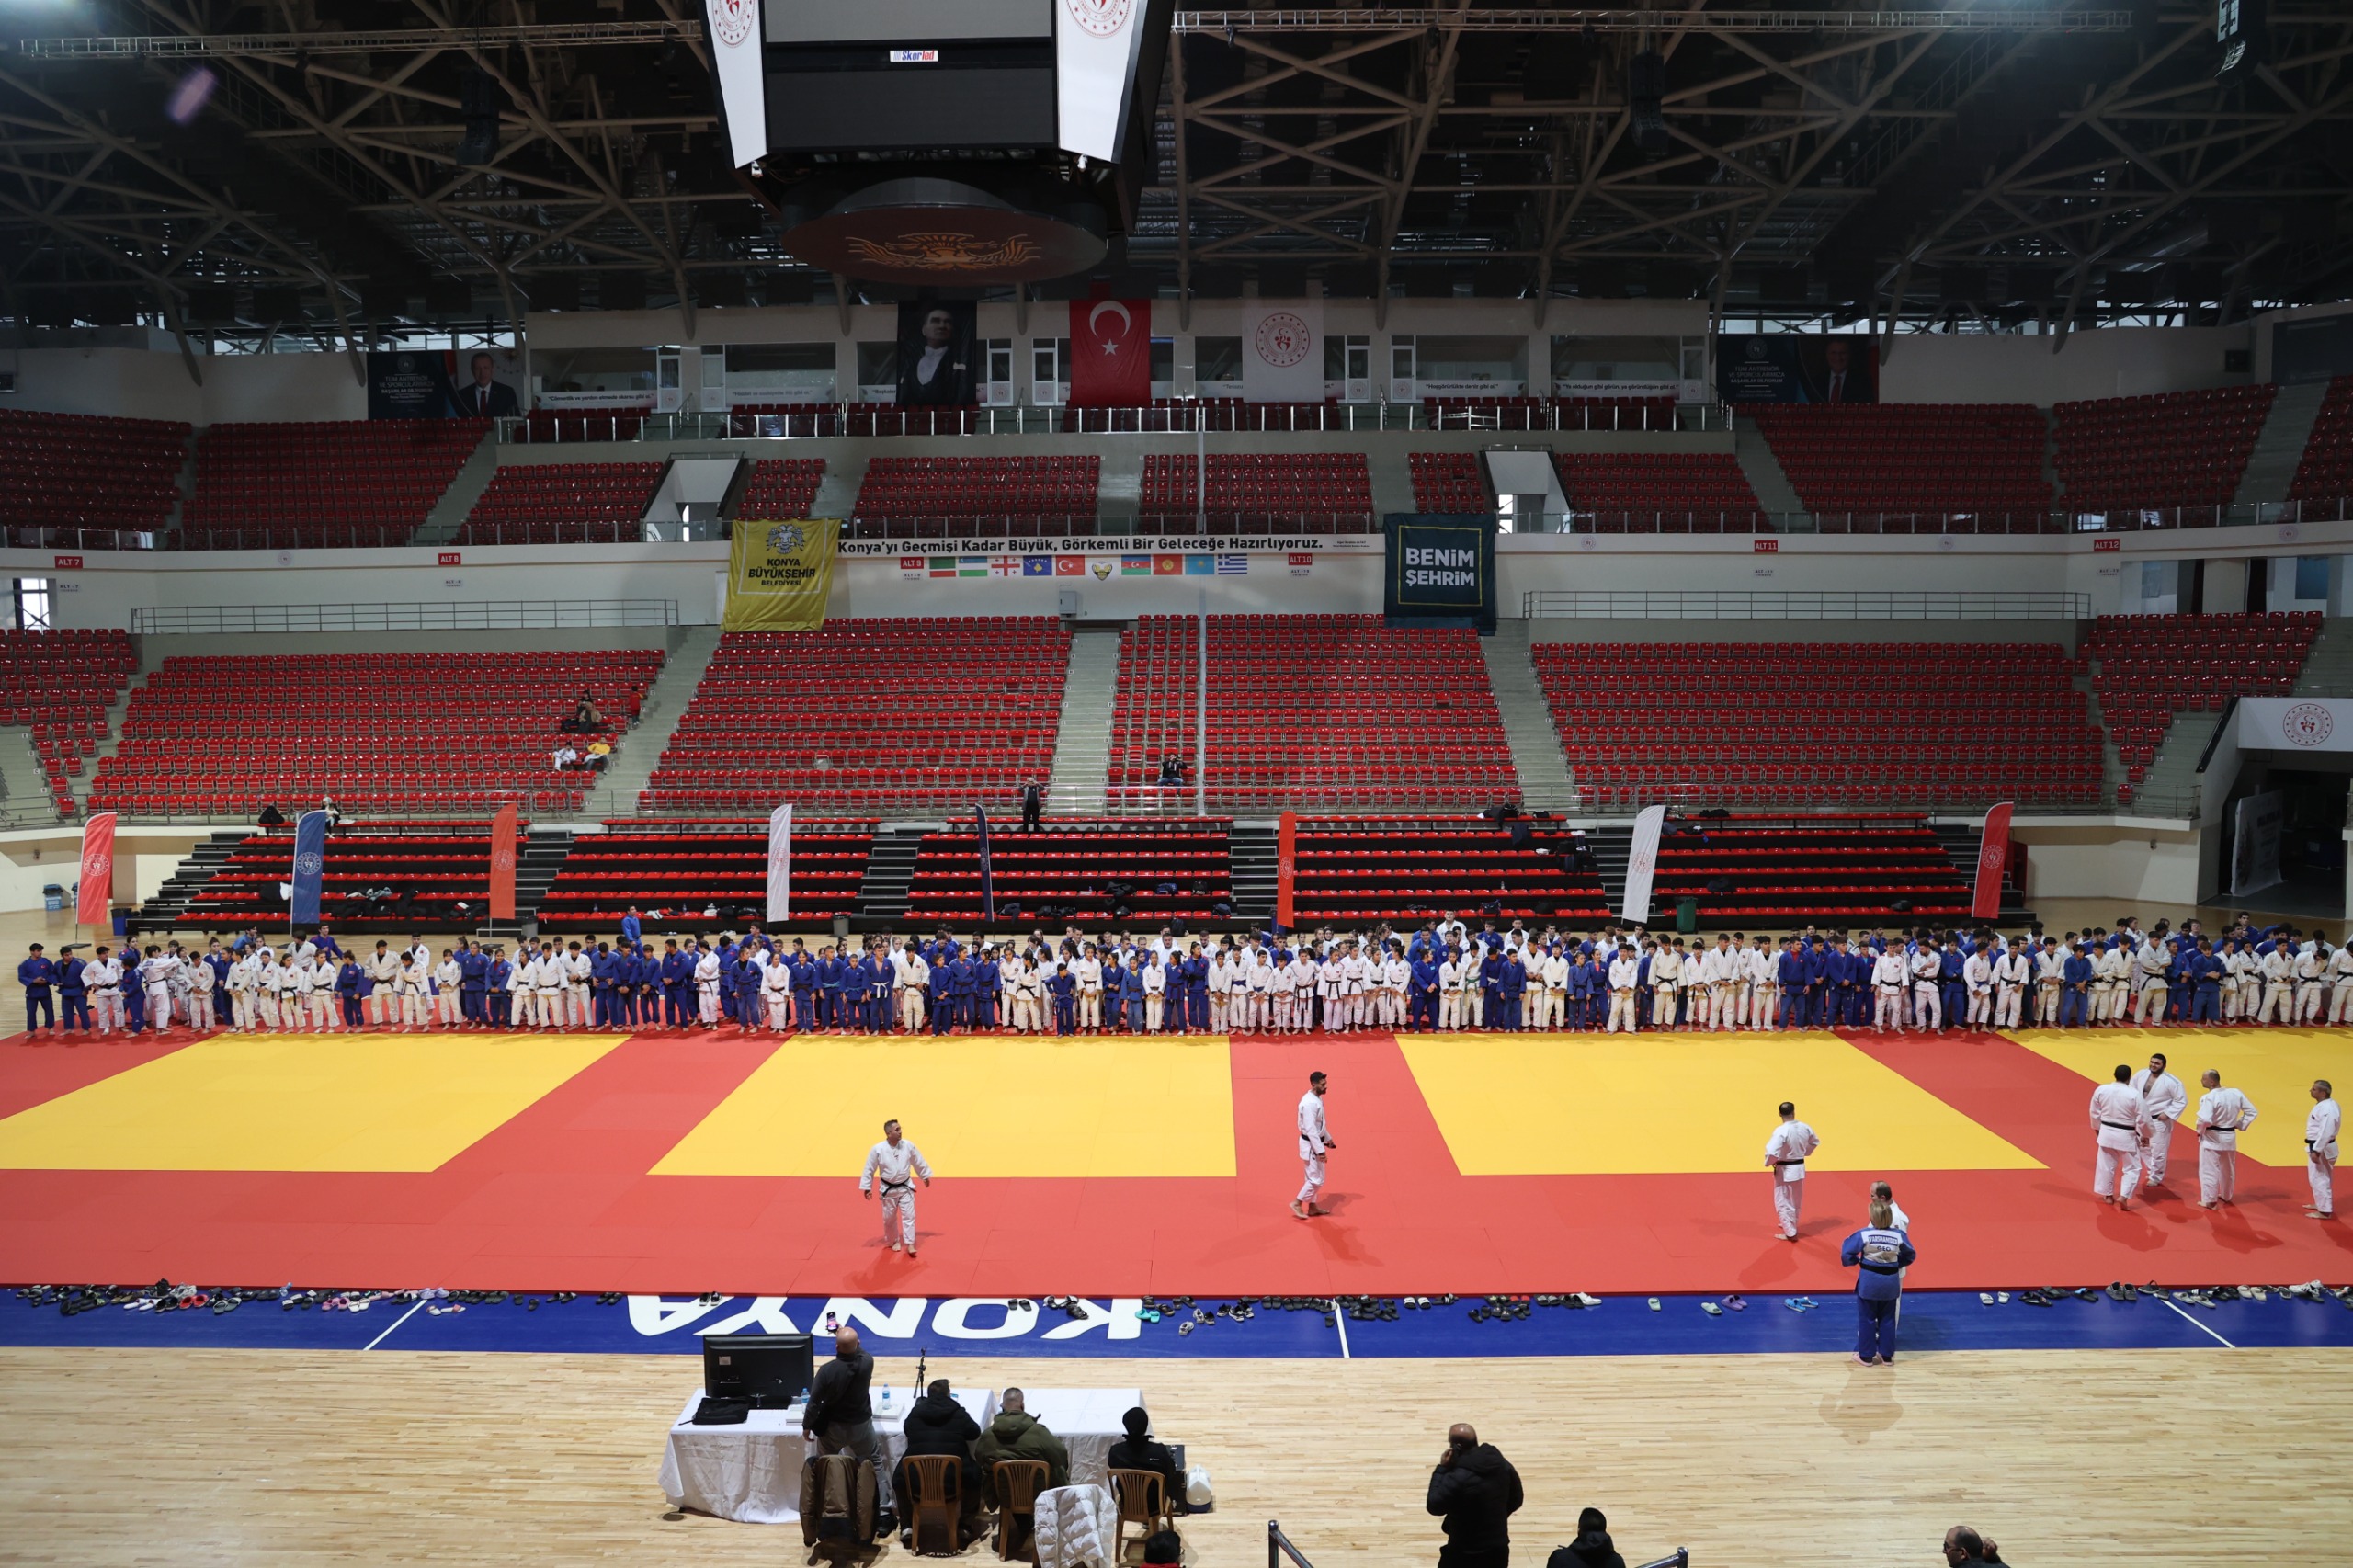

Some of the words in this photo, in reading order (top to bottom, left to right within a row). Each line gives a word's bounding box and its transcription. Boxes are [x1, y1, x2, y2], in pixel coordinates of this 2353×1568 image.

[902, 50, 935, 61] Skorled
[902, 540, 958, 553] Geçmişi
[961, 540, 1005, 551] Kadar
[1009, 539, 1058, 552] Büyük,
[1062, 539, 1129, 550] Görkemli
[1132, 539, 1154, 550] Bir
[1158, 538, 1225, 551] Geleceğe
[1229, 538, 1323, 551] Hazırlıyoruz.
[58, 558, 73, 566] ALT
[74, 558, 80, 566] 7
[767, 558, 801, 566] KONYA
[1289, 555, 1302, 563] ALT
[1302, 555, 1312, 563] 10
[748, 566, 816, 579] BÜYÜKŞEHİR
[627, 1297, 1143, 1340] KONYA
